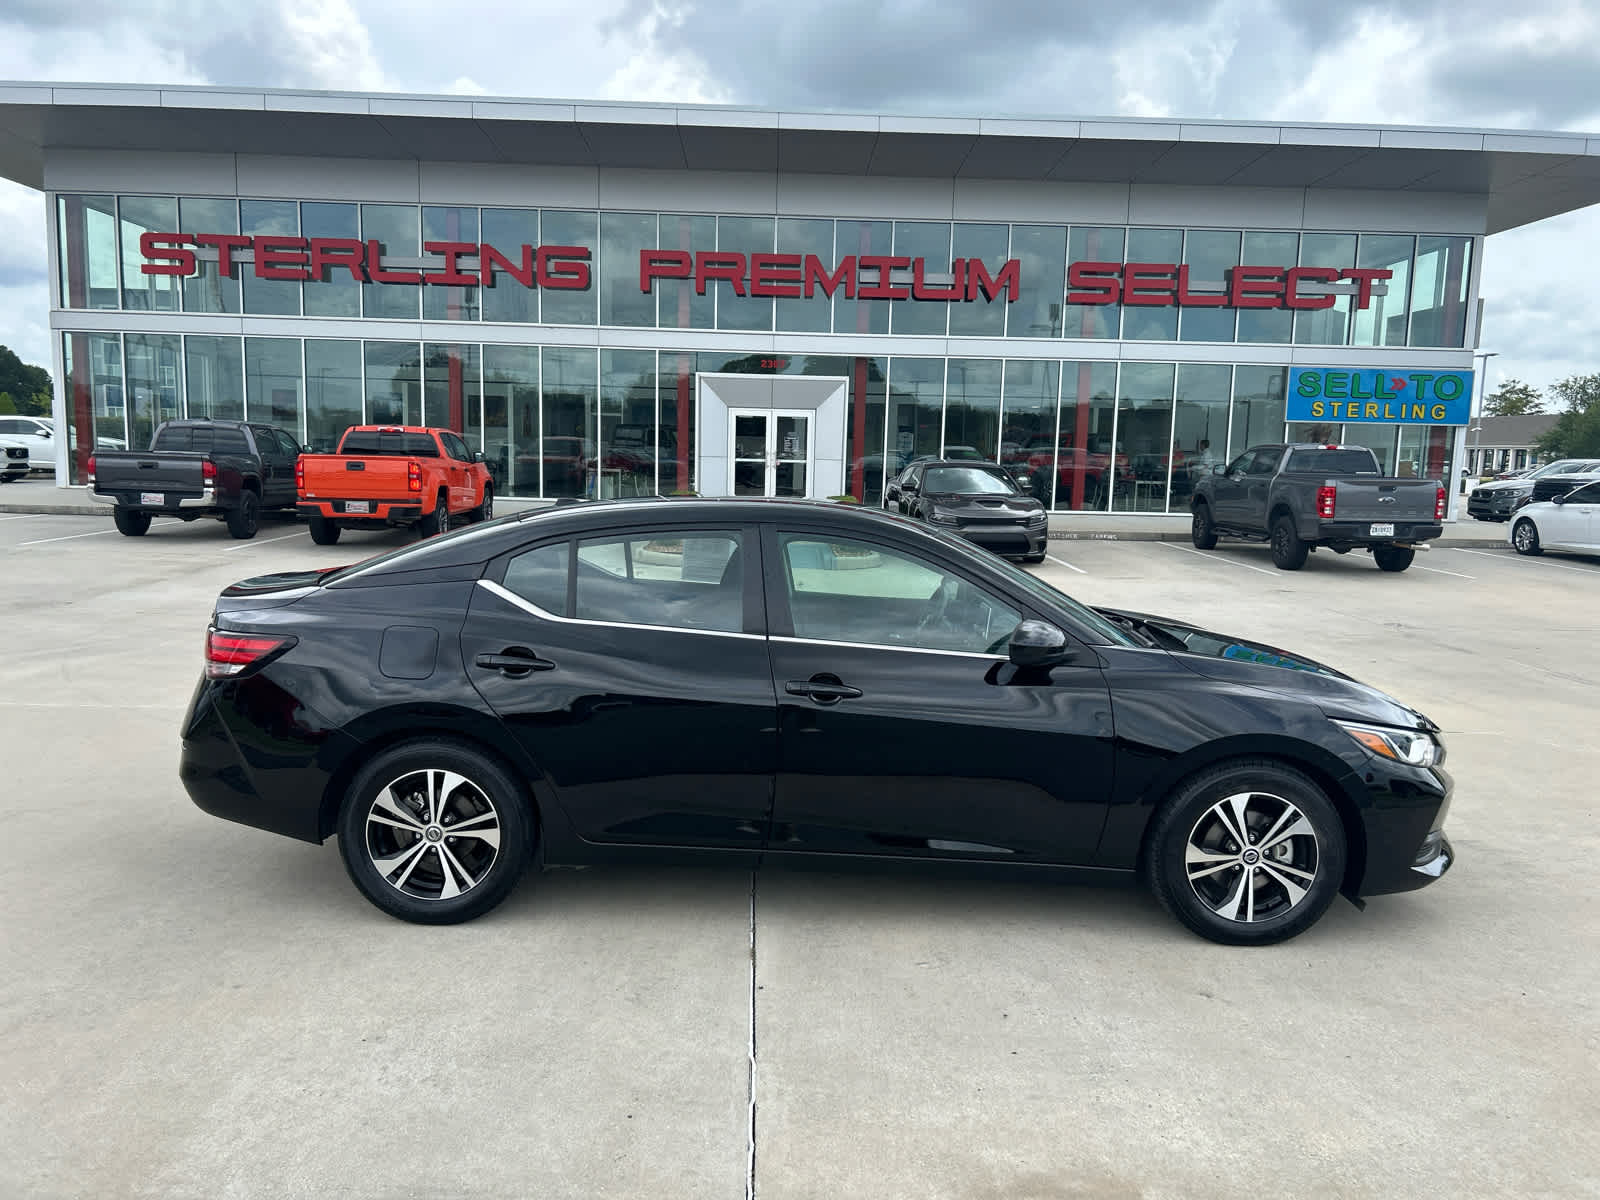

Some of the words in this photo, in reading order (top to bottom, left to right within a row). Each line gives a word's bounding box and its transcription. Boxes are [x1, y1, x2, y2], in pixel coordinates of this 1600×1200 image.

[140, 232, 592, 291] STERLING
[639, 250, 1020, 301] PREMIUM
[1067, 261, 1393, 309] SELECT
[1297, 371, 1397, 400] SELL
[1409, 373, 1465, 401] TO
[1311, 401, 1447, 420] STERLING
